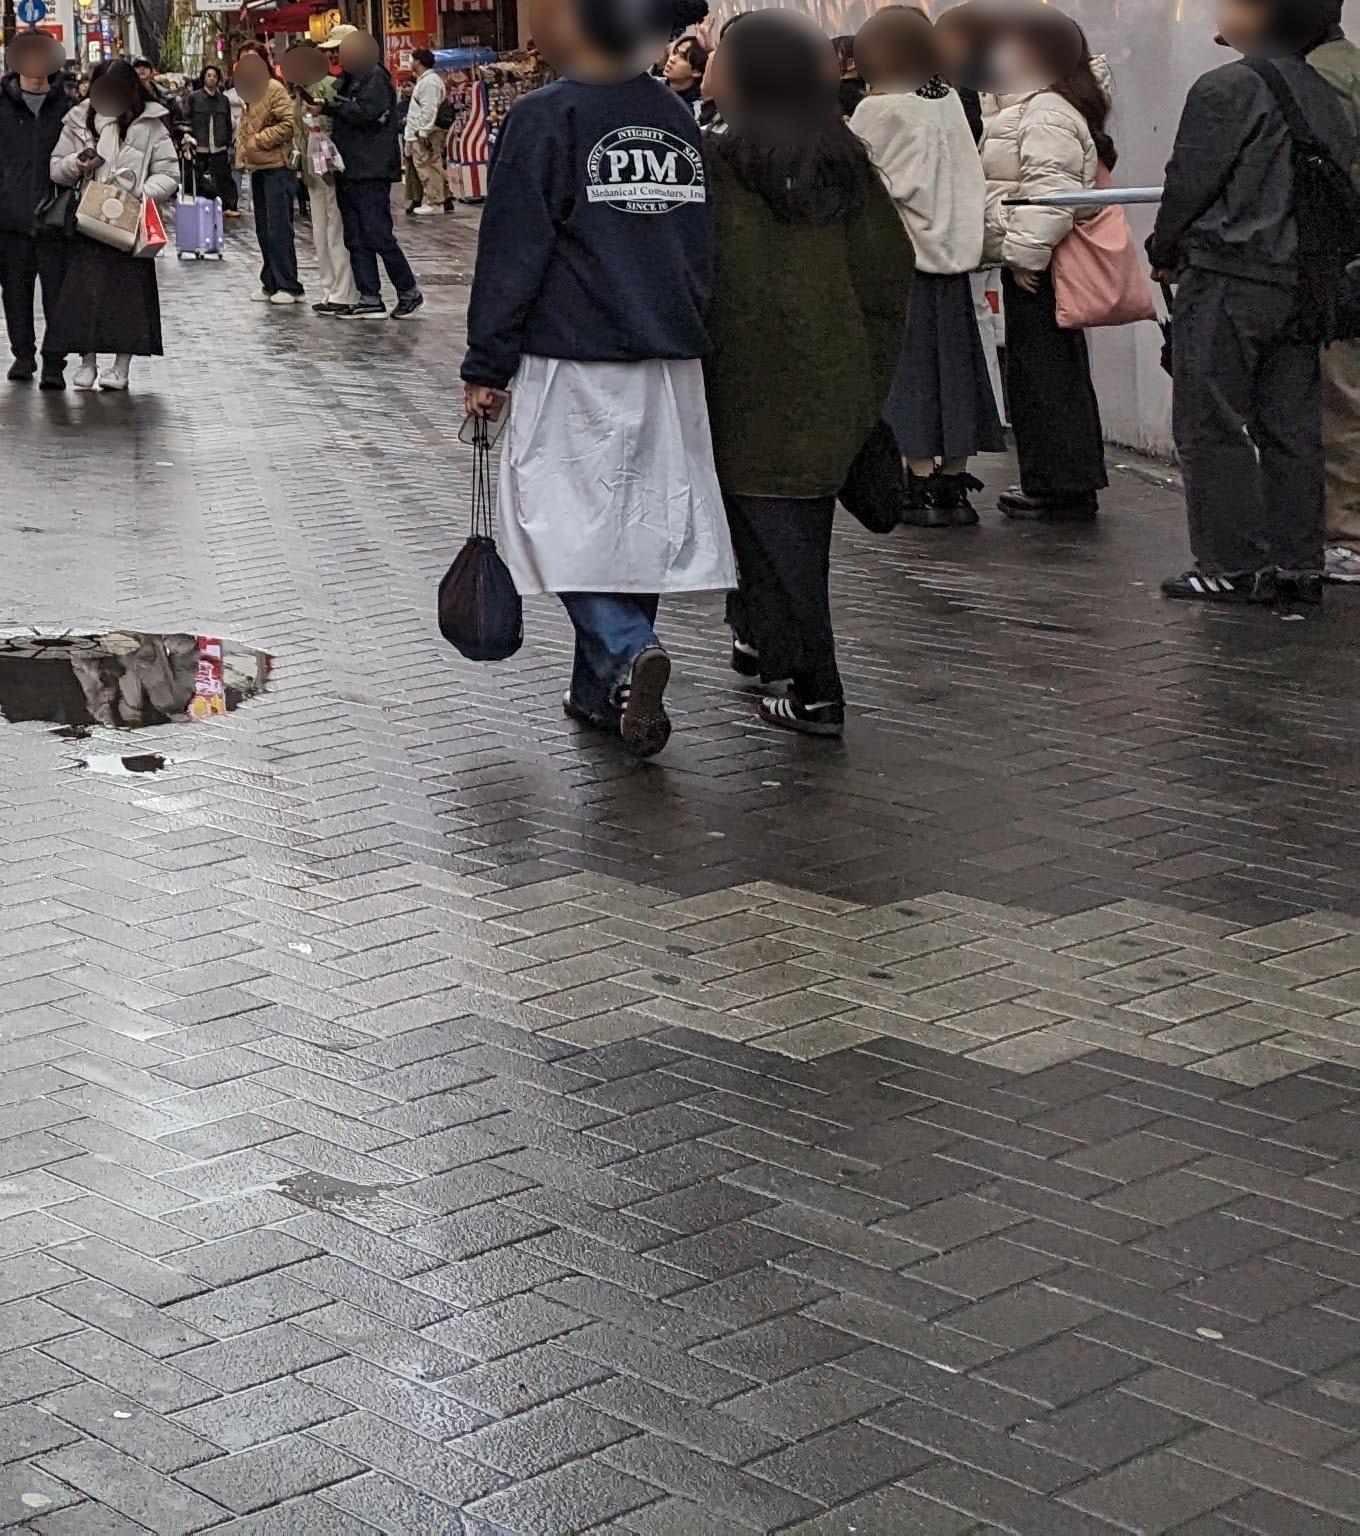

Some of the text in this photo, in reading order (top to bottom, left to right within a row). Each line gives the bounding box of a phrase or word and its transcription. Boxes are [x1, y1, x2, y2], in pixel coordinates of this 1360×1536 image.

[618, 128, 666, 141] INTEGRITY
[606, 149, 679, 183] PJM
[591, 187, 637, 199] Mechanical
[626, 202, 656, 211] SINCE
